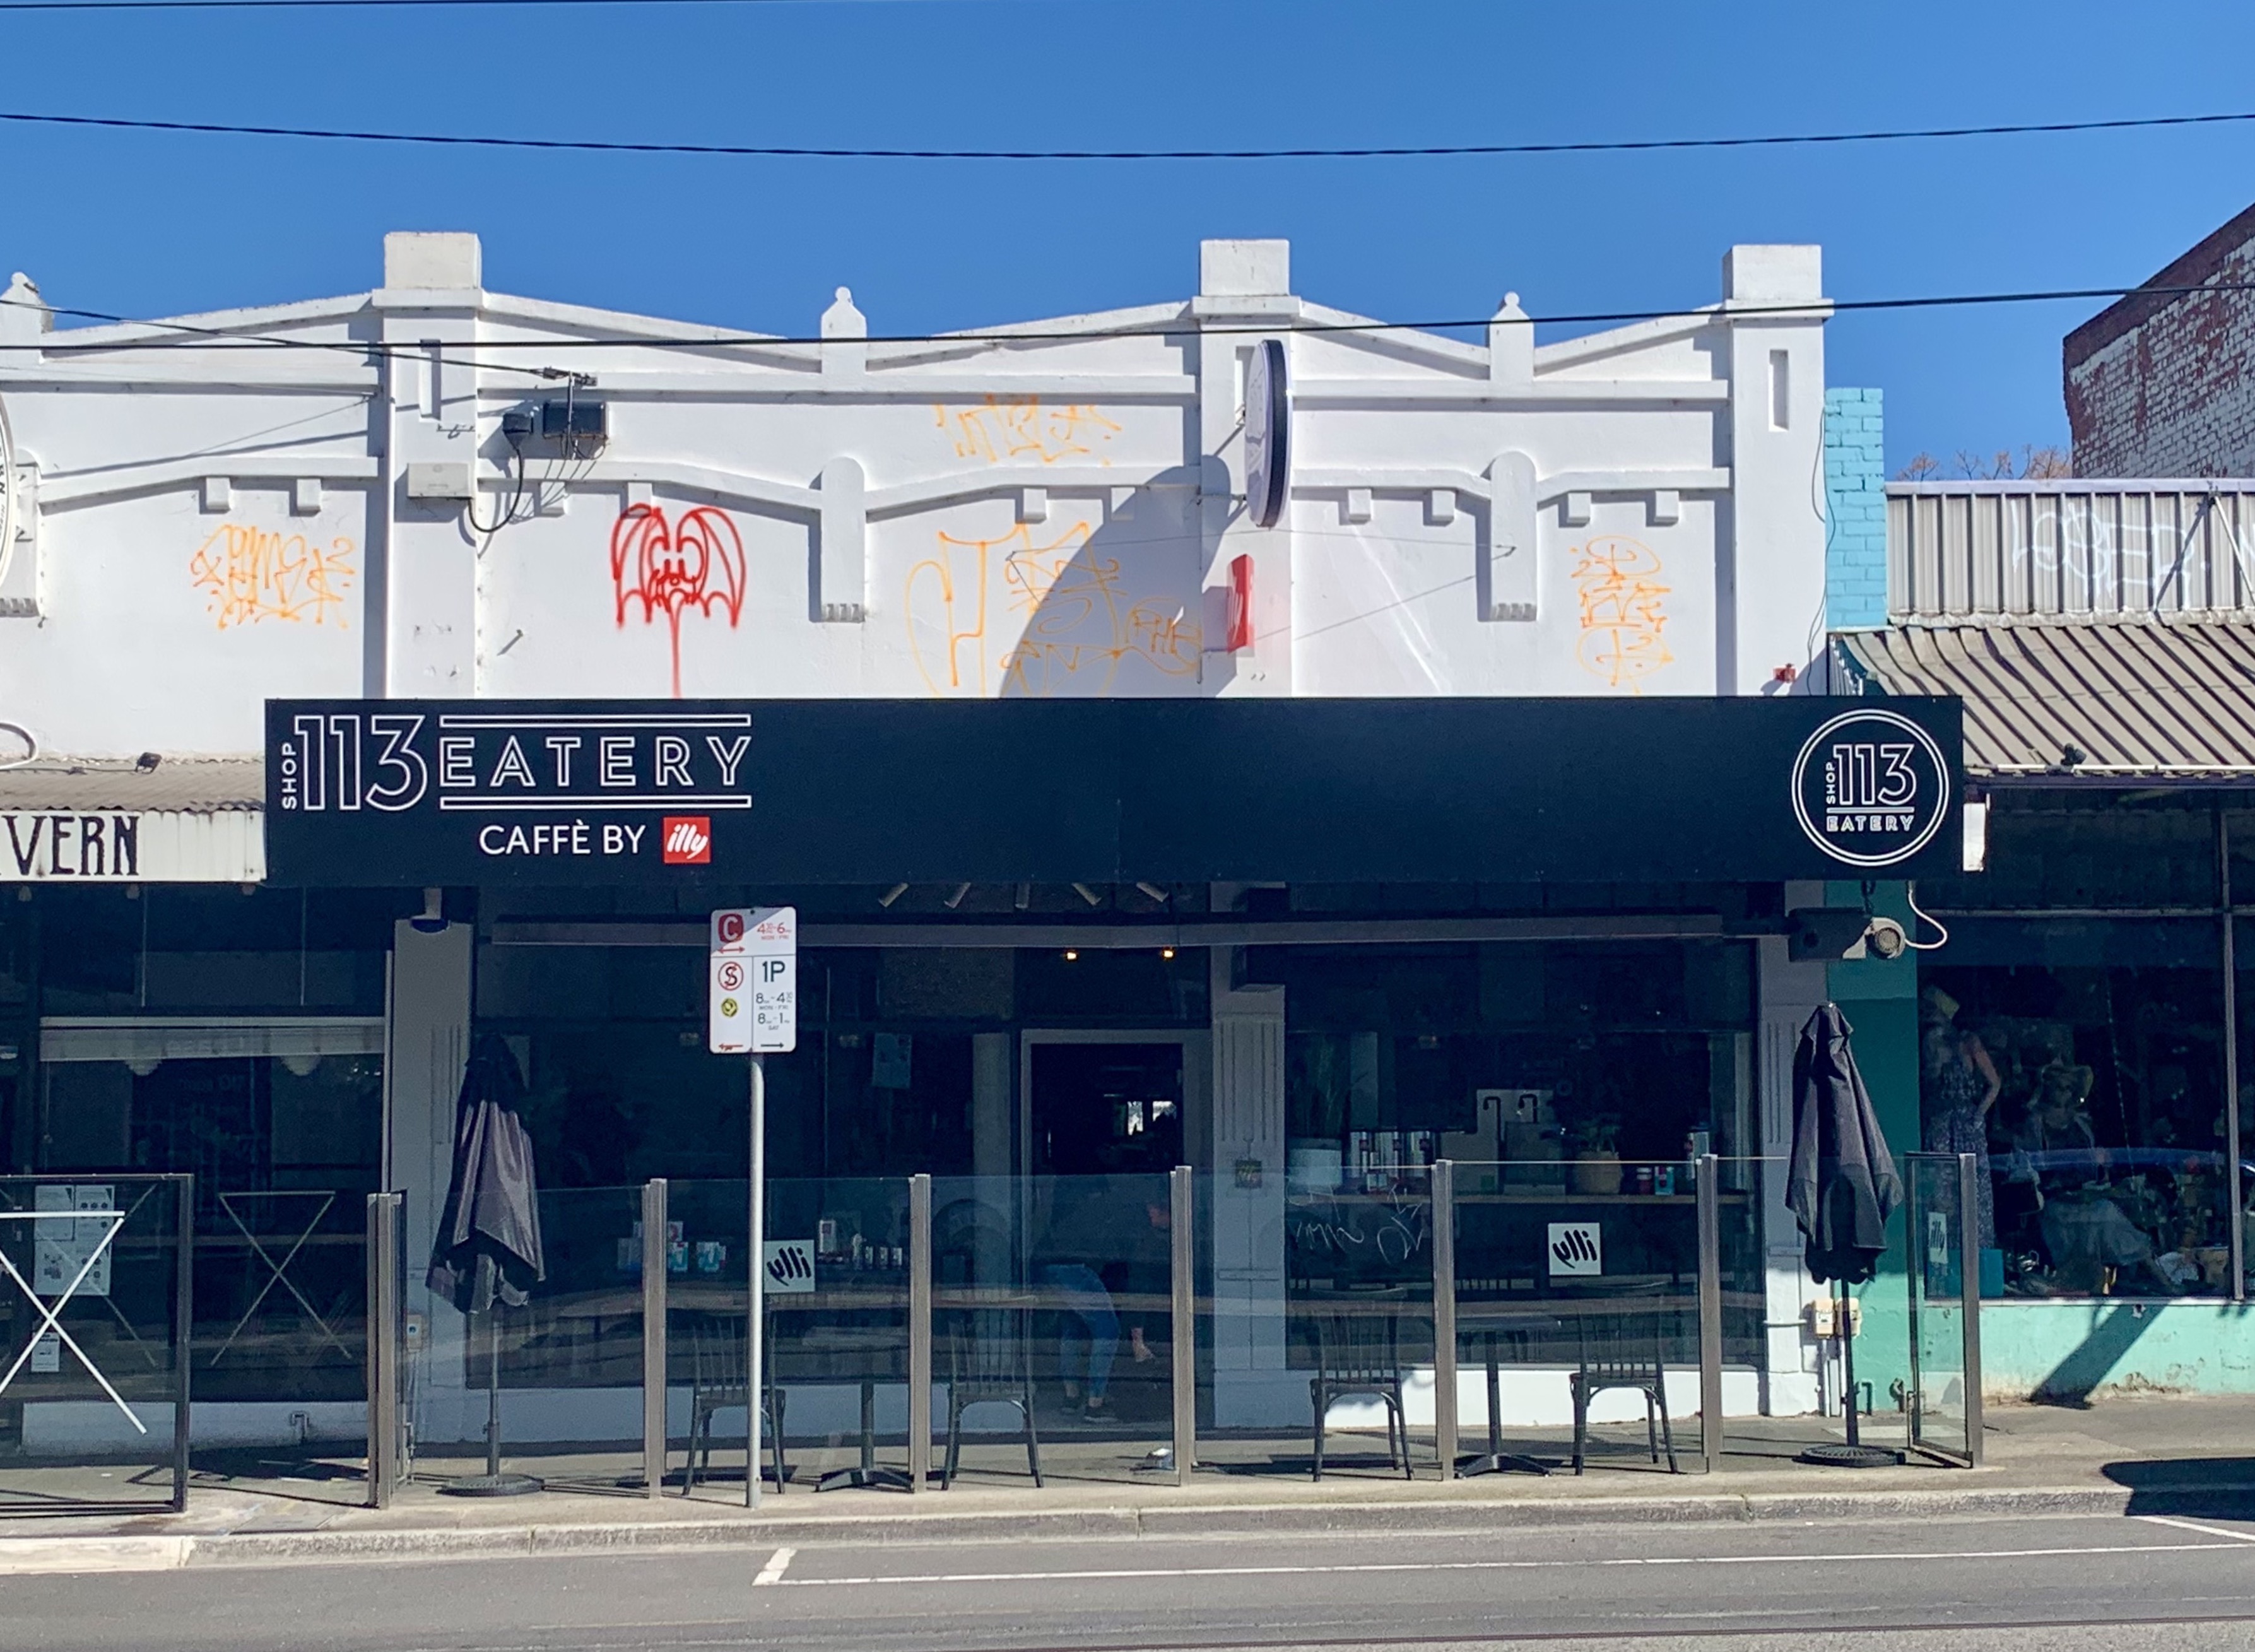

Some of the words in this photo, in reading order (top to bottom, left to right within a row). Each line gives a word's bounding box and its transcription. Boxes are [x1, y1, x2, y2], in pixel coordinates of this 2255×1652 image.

[281, 742, 297, 810] SHOP
[295, 715, 428, 810] 113
[440, 736, 751, 786] EATERY
[1825, 762, 1836, 805] SHOP
[1833, 744, 1917, 805] 113
[0, 815, 140, 876] VERN
[479, 819, 591, 855] CAFFÈ
[603, 825, 645, 854] BY
[666, 823, 708, 859] illy
[1826, 815, 1914, 832] EATERY
[762, 961, 786, 982] 1P
